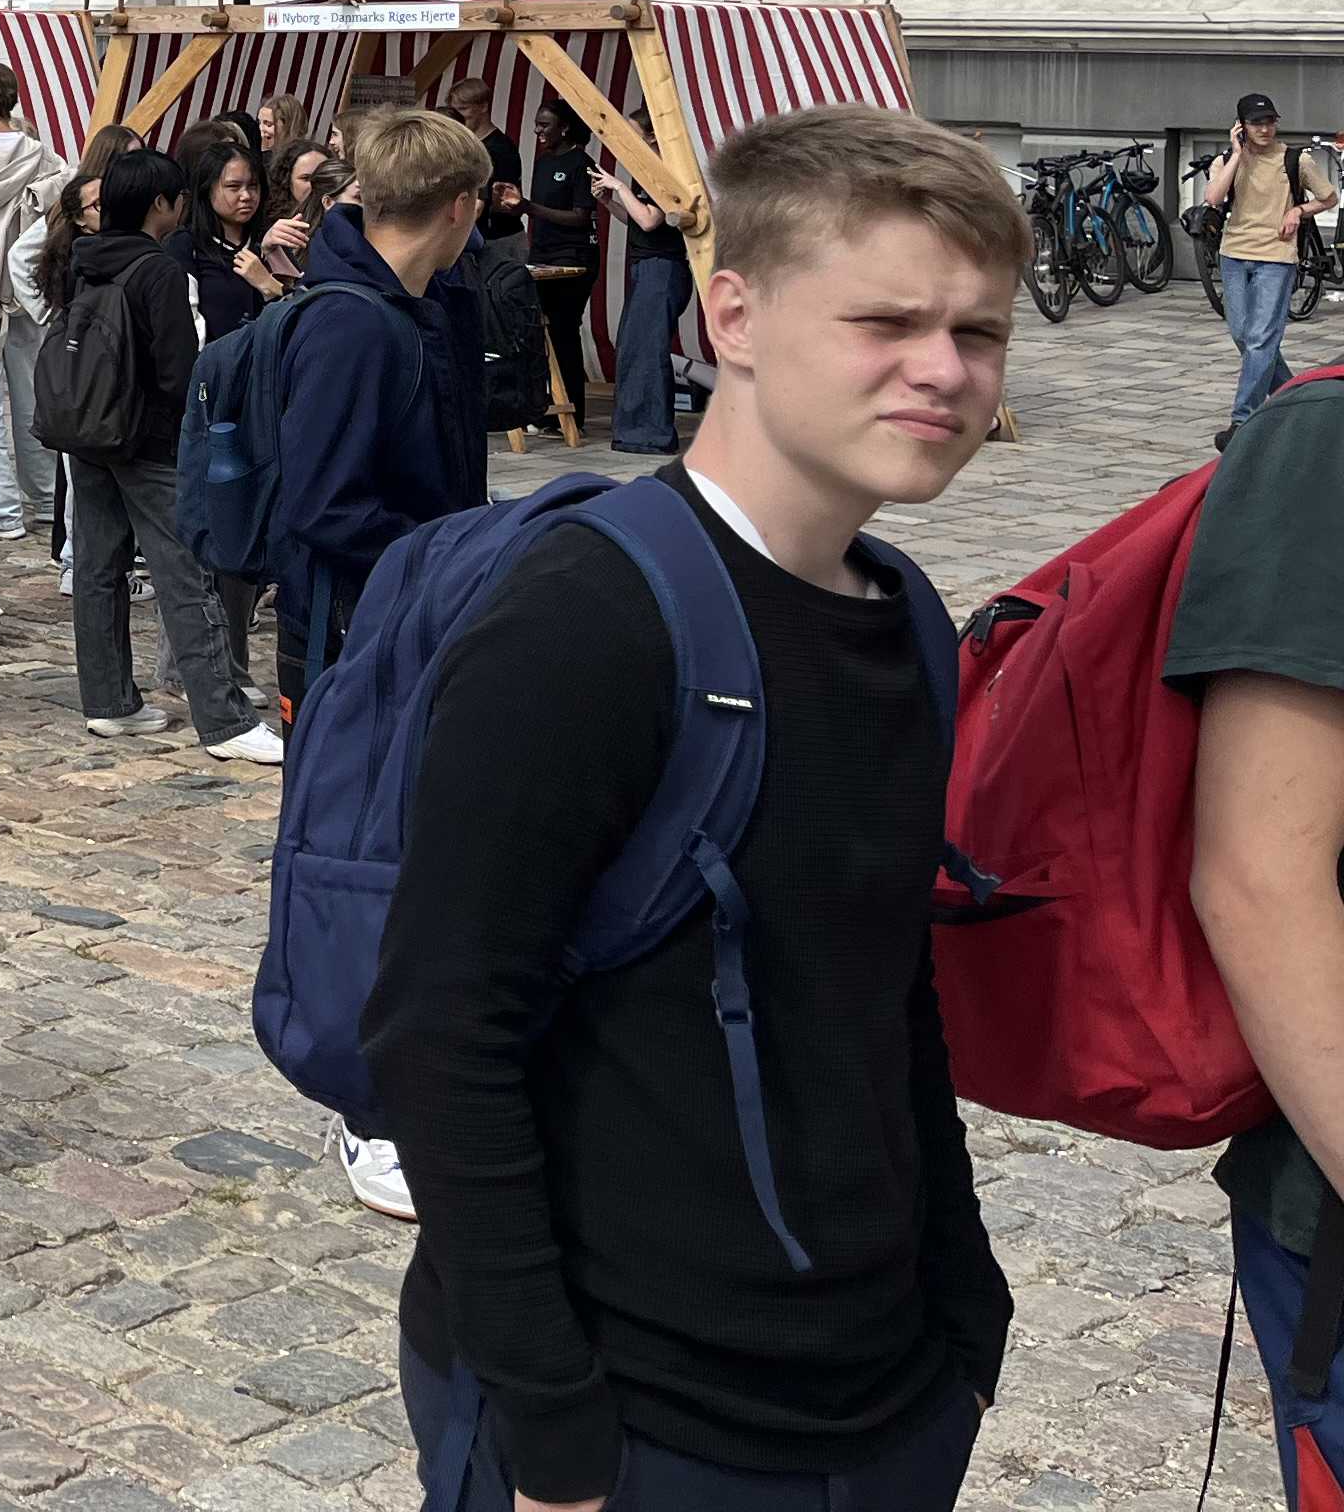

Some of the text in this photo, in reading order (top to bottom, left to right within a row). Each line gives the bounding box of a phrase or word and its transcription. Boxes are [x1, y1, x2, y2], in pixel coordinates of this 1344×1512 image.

[282, 13, 320, 26] Nyborg
[330, 11, 385, 24] Danmarks
[388, 11, 417, 24] Riges
[421, 10, 456, 23] Hjerte
